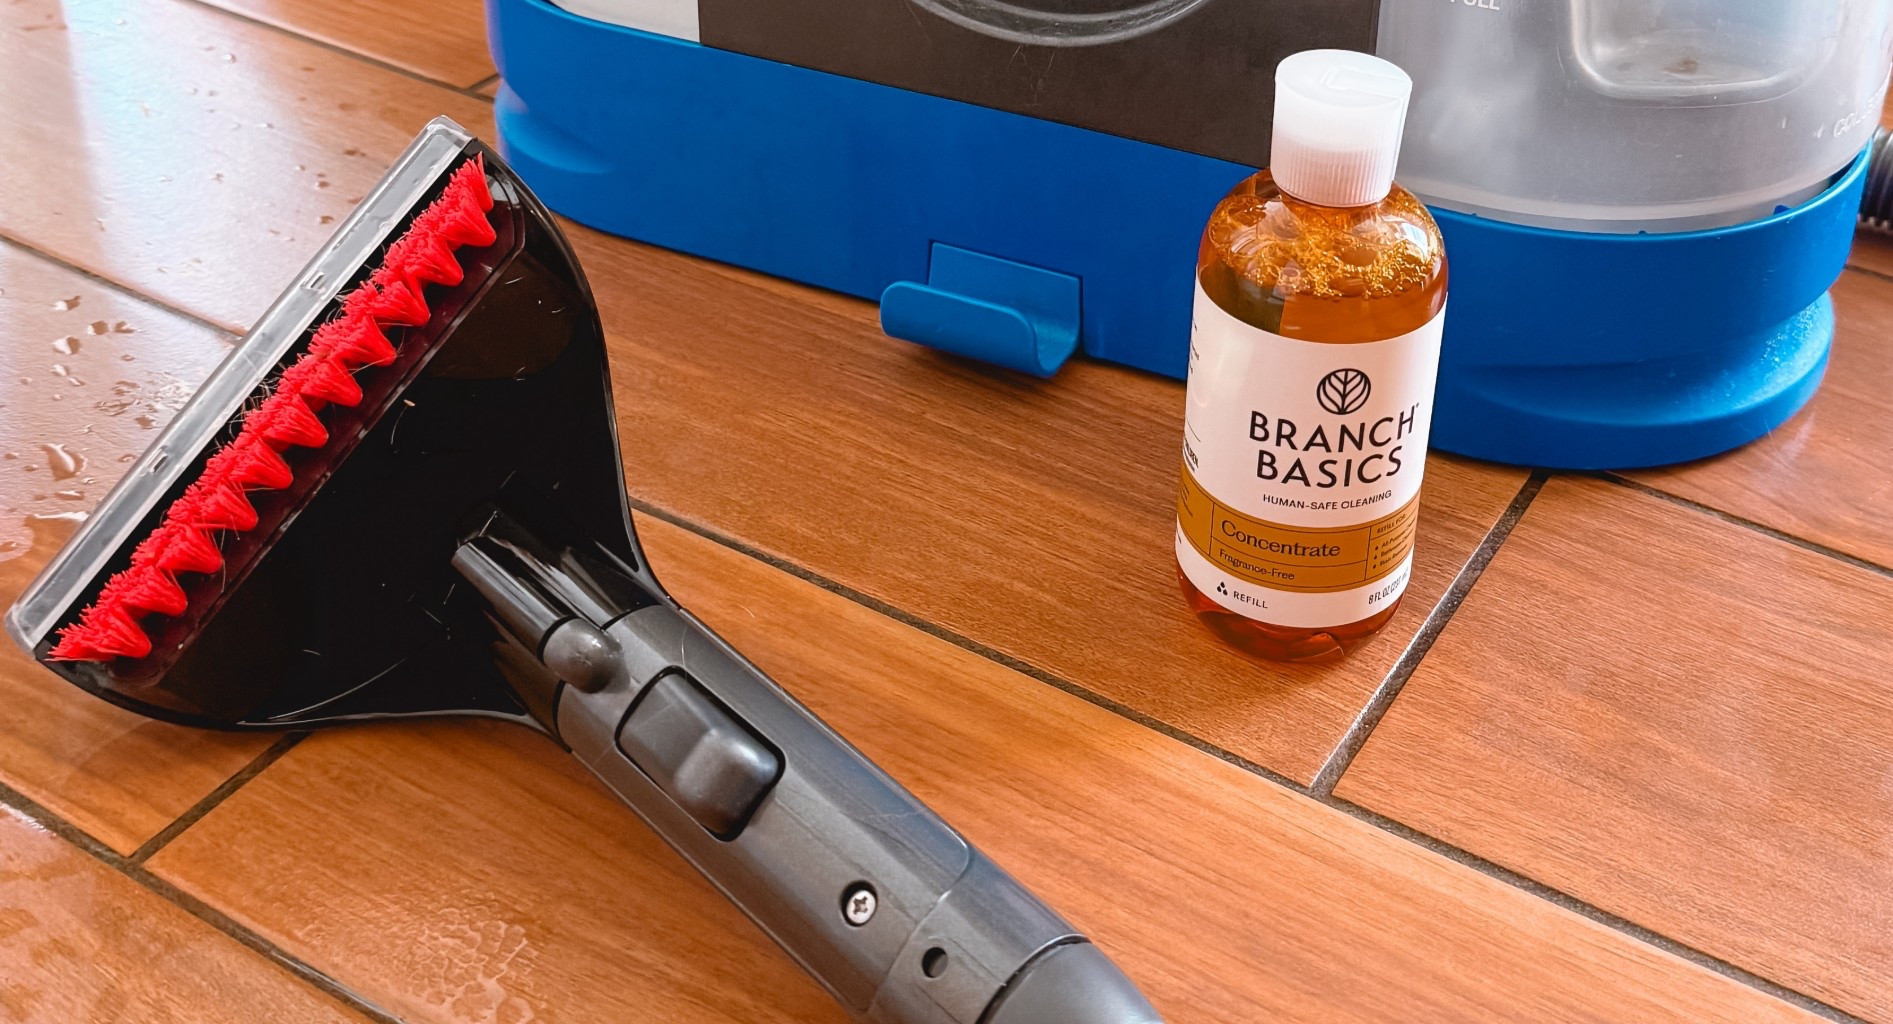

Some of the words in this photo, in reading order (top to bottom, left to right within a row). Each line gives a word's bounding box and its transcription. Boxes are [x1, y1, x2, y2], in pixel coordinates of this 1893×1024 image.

[1249, 404, 1416, 453] BRANCH
[1256, 445, 1402, 488] BASICS
[1263, 493, 1338, 510] HUMAN-SAFE
[1341, 489, 1392, 509] CLEANING
[1221, 519, 1341, 557] Concentrate
[1219, 548, 1295, 580] Fragrance-Free
[1233, 590, 1268, 609] REFILL
